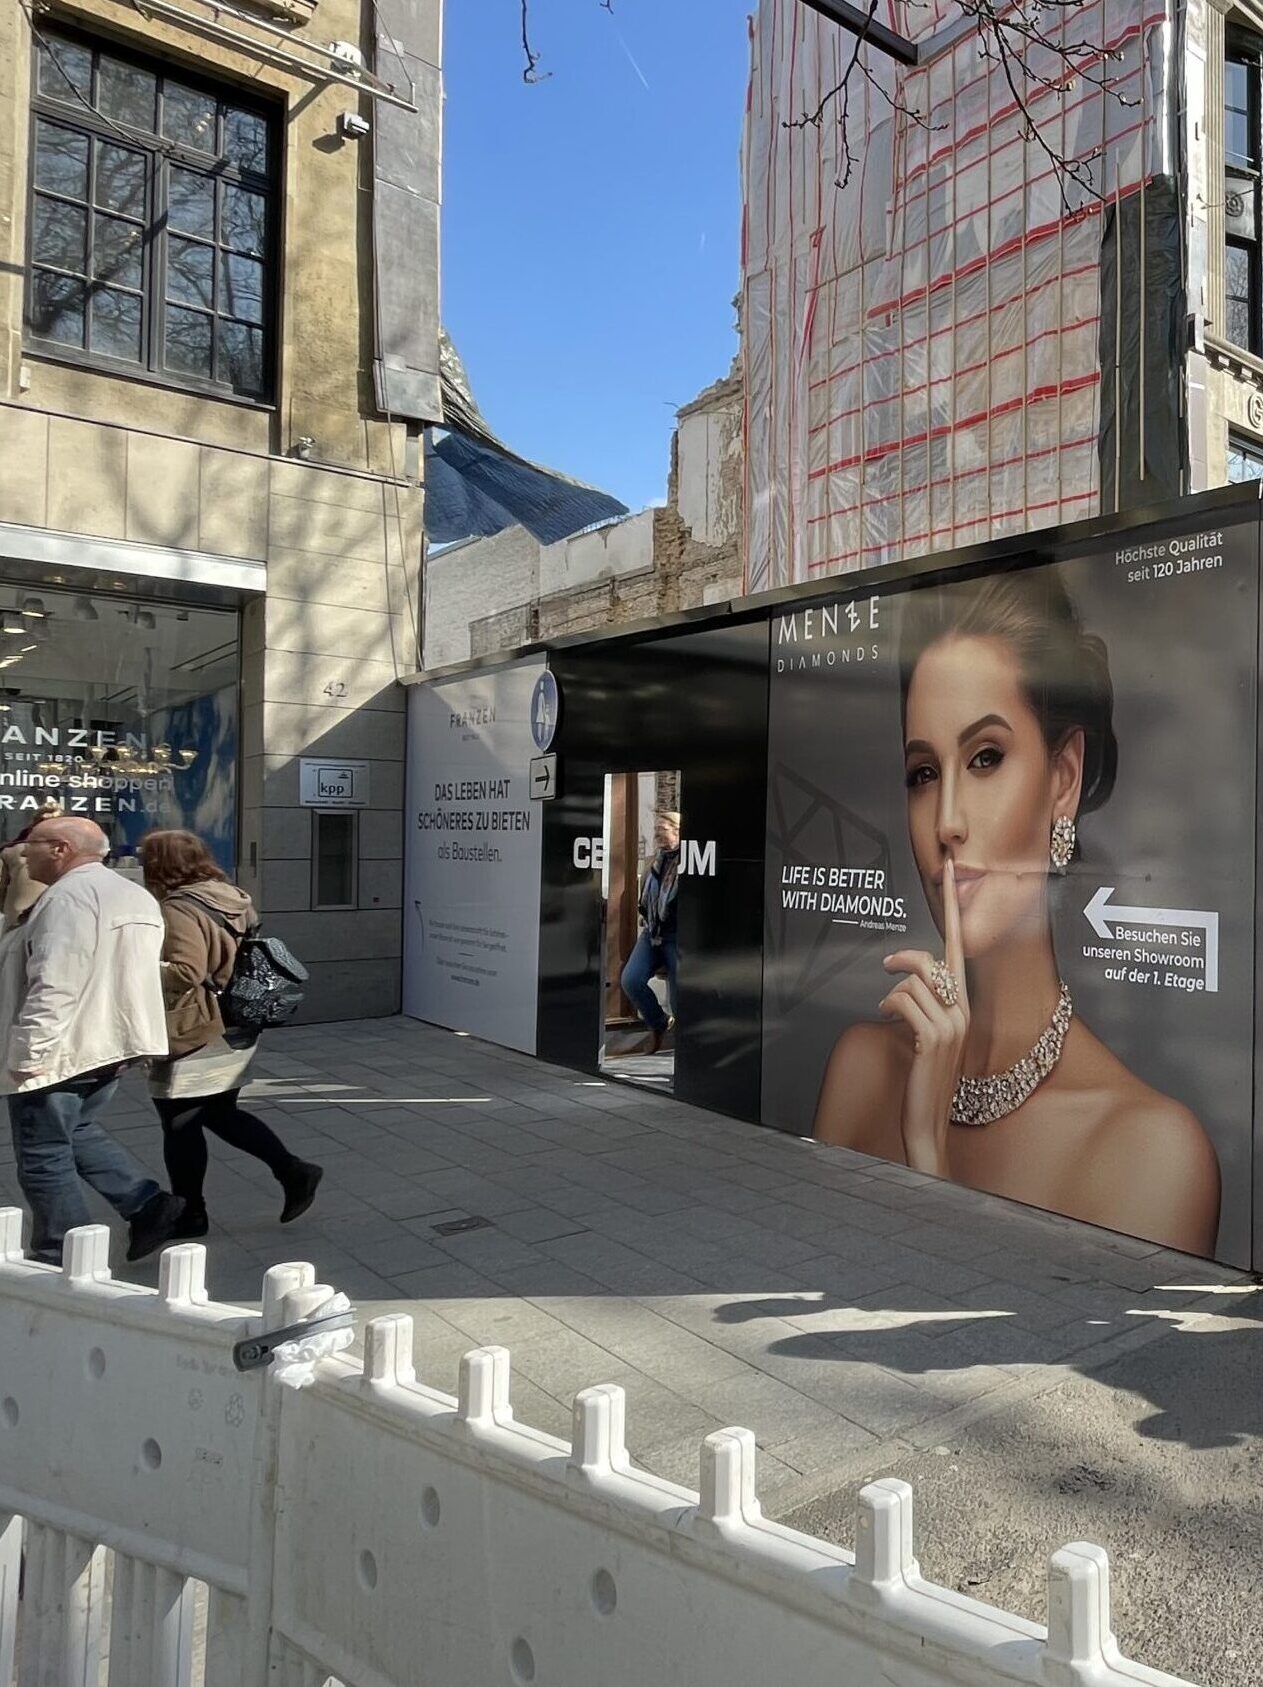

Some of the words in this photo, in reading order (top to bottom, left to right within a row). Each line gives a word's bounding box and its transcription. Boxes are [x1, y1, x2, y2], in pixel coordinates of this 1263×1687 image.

[1115, 545, 1167, 565] Höchste
[1168, 531, 1224, 556] Qualität
[1128, 566, 1150, 583] seit
[1153, 562, 1174, 578] 120
[1176, 555, 1223, 575] Jahren
[778, 595, 880, 645] MENZE
[777, 644, 880, 673] DIAMONDS
[323, 682, 348, 698] 42
[4, 752, 41, 762] SEIT
[49, 753, 85, 764] 1820
[320, 782, 345, 796] kpp
[434, 783, 453, 801] DAS
[455, 781, 486, 801] LEBEN
[489, 779, 511, 800] HAT
[418, 808, 474, 831] SCHÖNERES
[476, 811, 490, 831] ZU
[492, 811, 531, 831] BIETEN
[438, 842, 451, 860] als
[452, 841, 502, 862] Baustellen.
[782, 866, 811, 885] LIFE
[812, 867, 826, 886] IS
[828, 868, 885, 889] BETTER
[782, 889, 818, 911] WITH
[820, 892, 907, 918] DIAMONDS.
[1115, 926, 1178, 945] Besuchen
[1180, 931, 1201, 947] Sie
[1082, 945, 1131, 961] unseren
[1134, 948, 1205, 969] Showroom
[1104, 966, 1127, 981] auf
[1128, 967, 1151, 984] der
[1153, 971, 1161, 986] 1.
[1163, 972, 1205, 992] Etage
